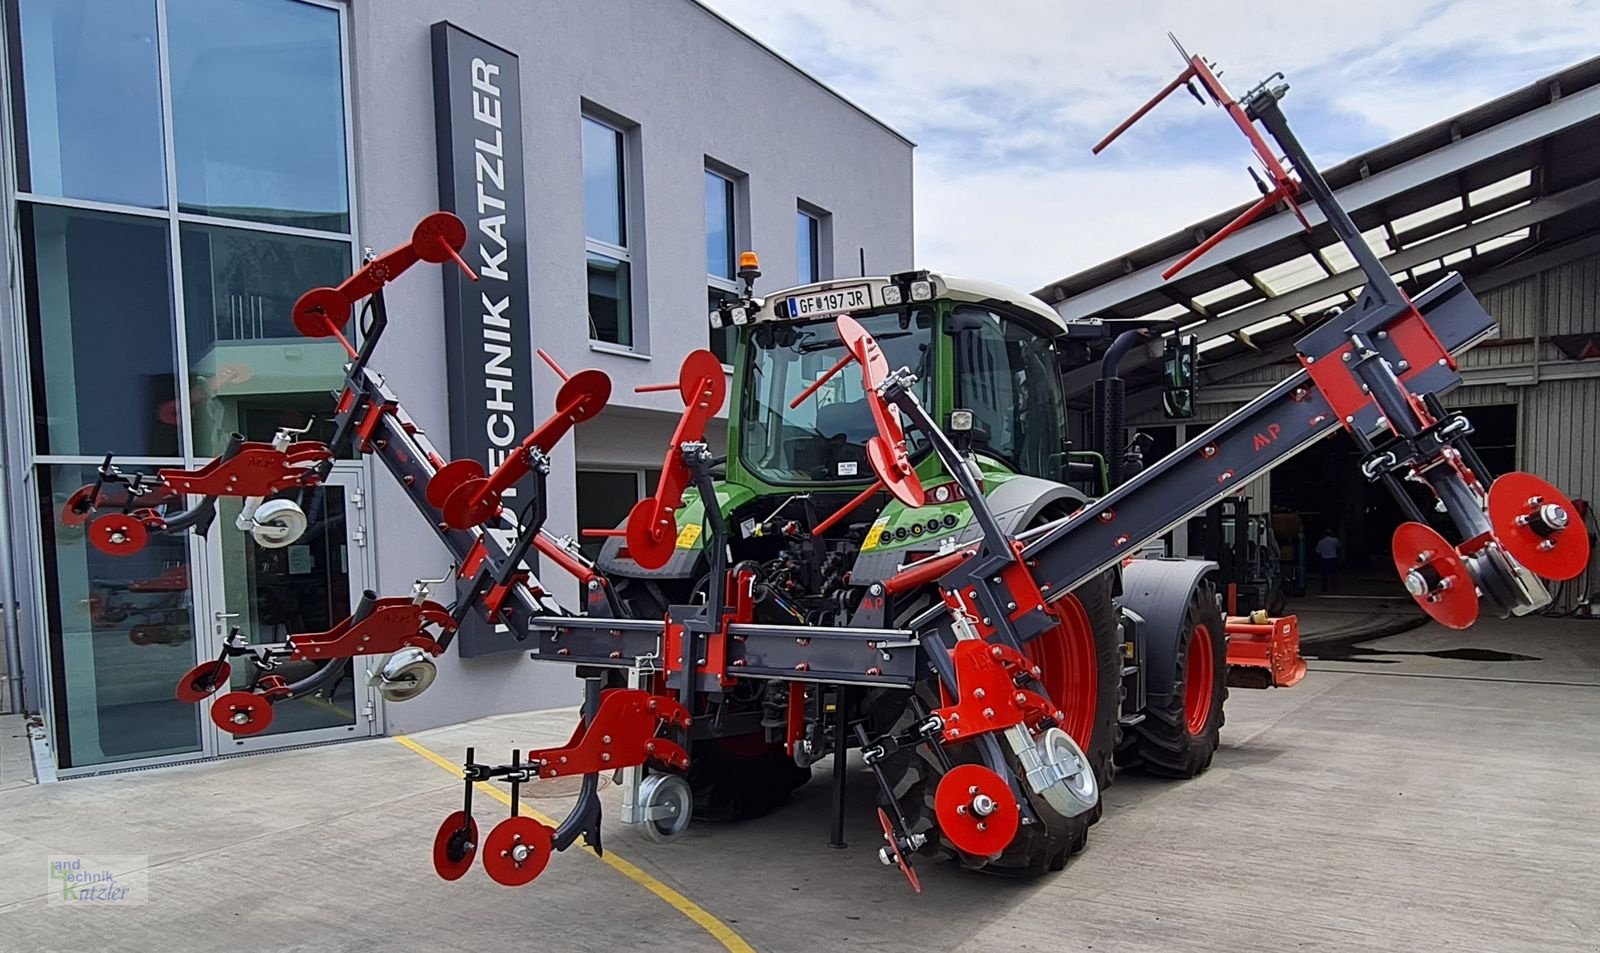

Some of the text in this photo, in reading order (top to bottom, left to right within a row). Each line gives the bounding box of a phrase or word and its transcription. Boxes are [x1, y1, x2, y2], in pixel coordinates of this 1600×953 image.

[471, 57, 509, 281] KATZLER
[799, 290, 864, 314] GF 197 JR
